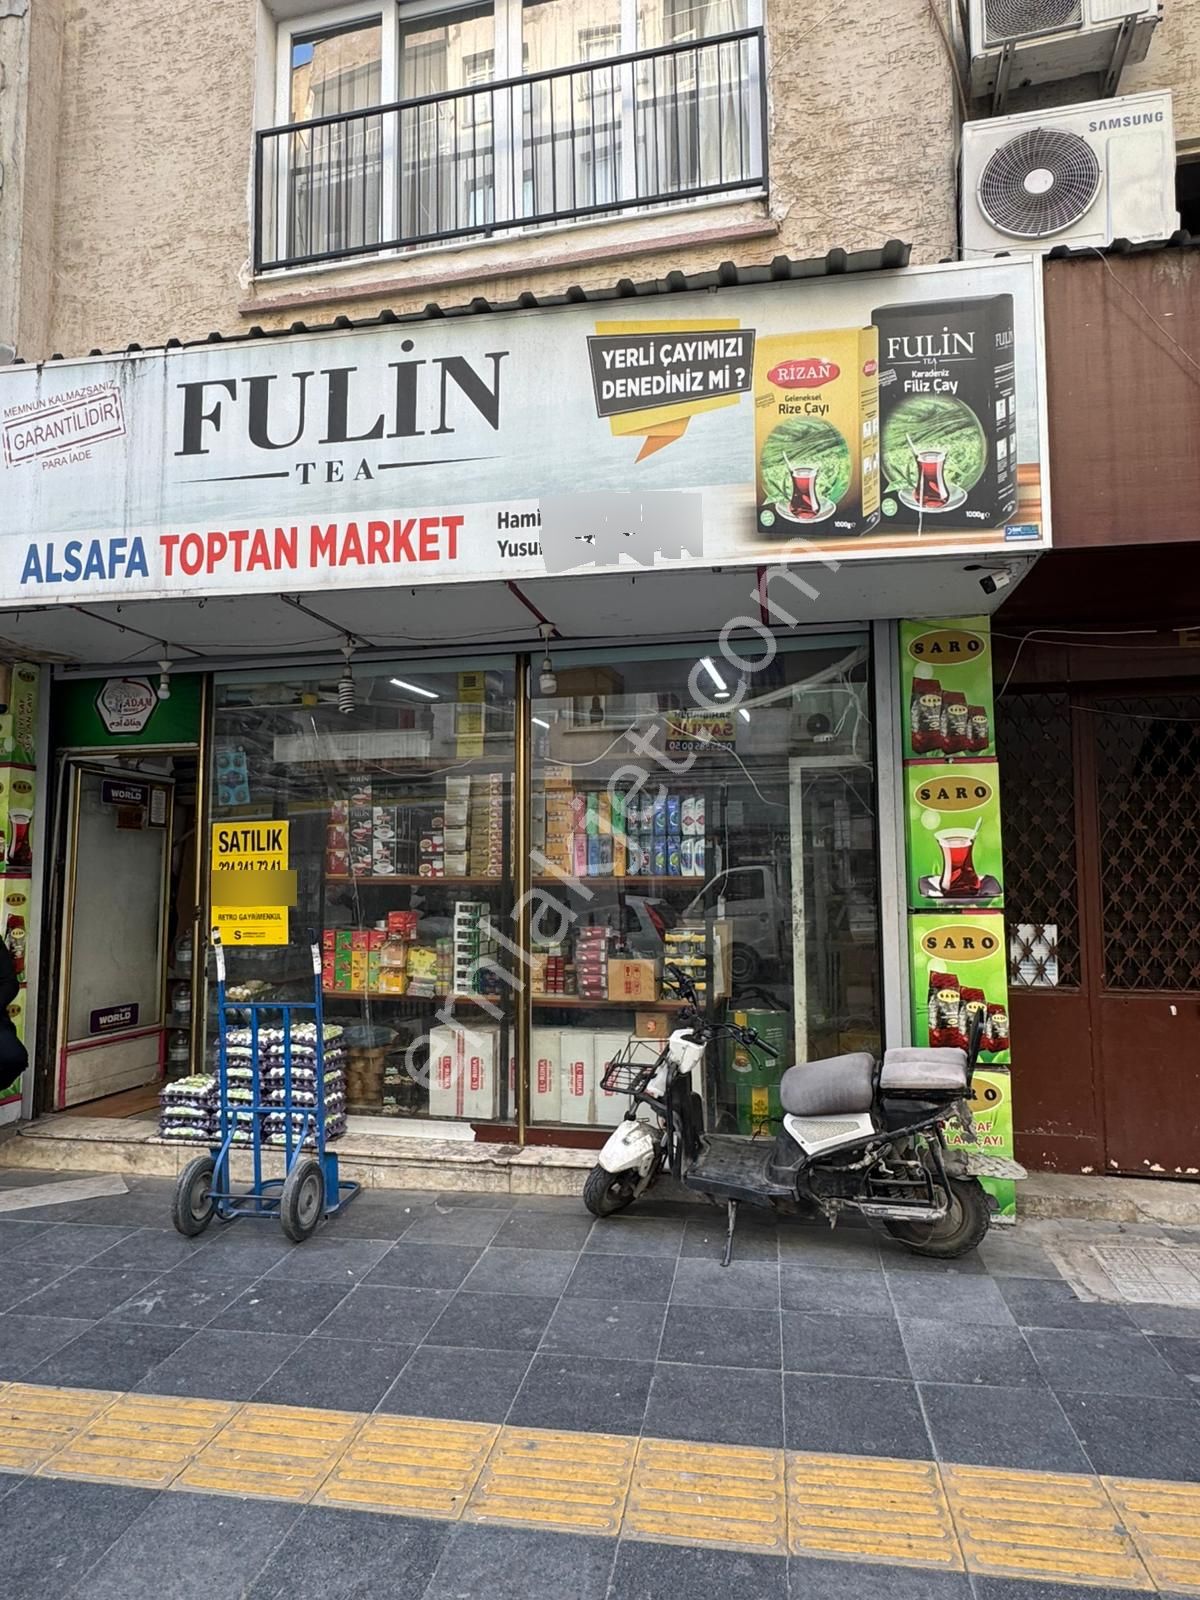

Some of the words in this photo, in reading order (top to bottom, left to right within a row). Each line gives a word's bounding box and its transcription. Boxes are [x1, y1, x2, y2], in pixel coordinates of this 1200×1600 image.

[1089, 112, 1163, 132] SAMSUNG
[887, 326, 976, 359] FULİN
[601, 342, 654, 369] YERLİ
[659, 337, 743, 367] ÇAYIMIZI
[911, 369, 950, 378] Karadeniz
[602, 368, 704, 400] DENEDİNİZ
[708, 364, 730, 389] Mİ
[735, 367, 745, 387] ?
[904, 380, 930, 393] Filiz
[933, 380, 959, 395] Çay
[3, 399, 46, 418] MEMNUN
[48, 380, 115, 405] KALMAZSANIZ
[174, 339, 510, 457] FULİN
[784, 393, 823, 403] Geleneksel
[778, 403, 802, 415] Rize
[804, 402, 830, 416] Çayı
[14, 402, 116, 451] GARANTİLİDİR
[42, 455, 68, 470] PARA
[296, 457, 376, 486] TEA
[21, 536, 150, 584] ALSAFA
[160, 526, 298, 577] TOPTAN
[310, 515, 465, 574] MARKET
[914, 639, 980, 654] SARO
[111, 789, 142, 800] WORLD
[920, 785, 987, 800] SARO
[218, 828, 283, 853] SATILIK
[218, 913, 238, 921] RETRO
[926, 937, 994, 949] SARO
[99, 1011, 131, 1025] WORLD
